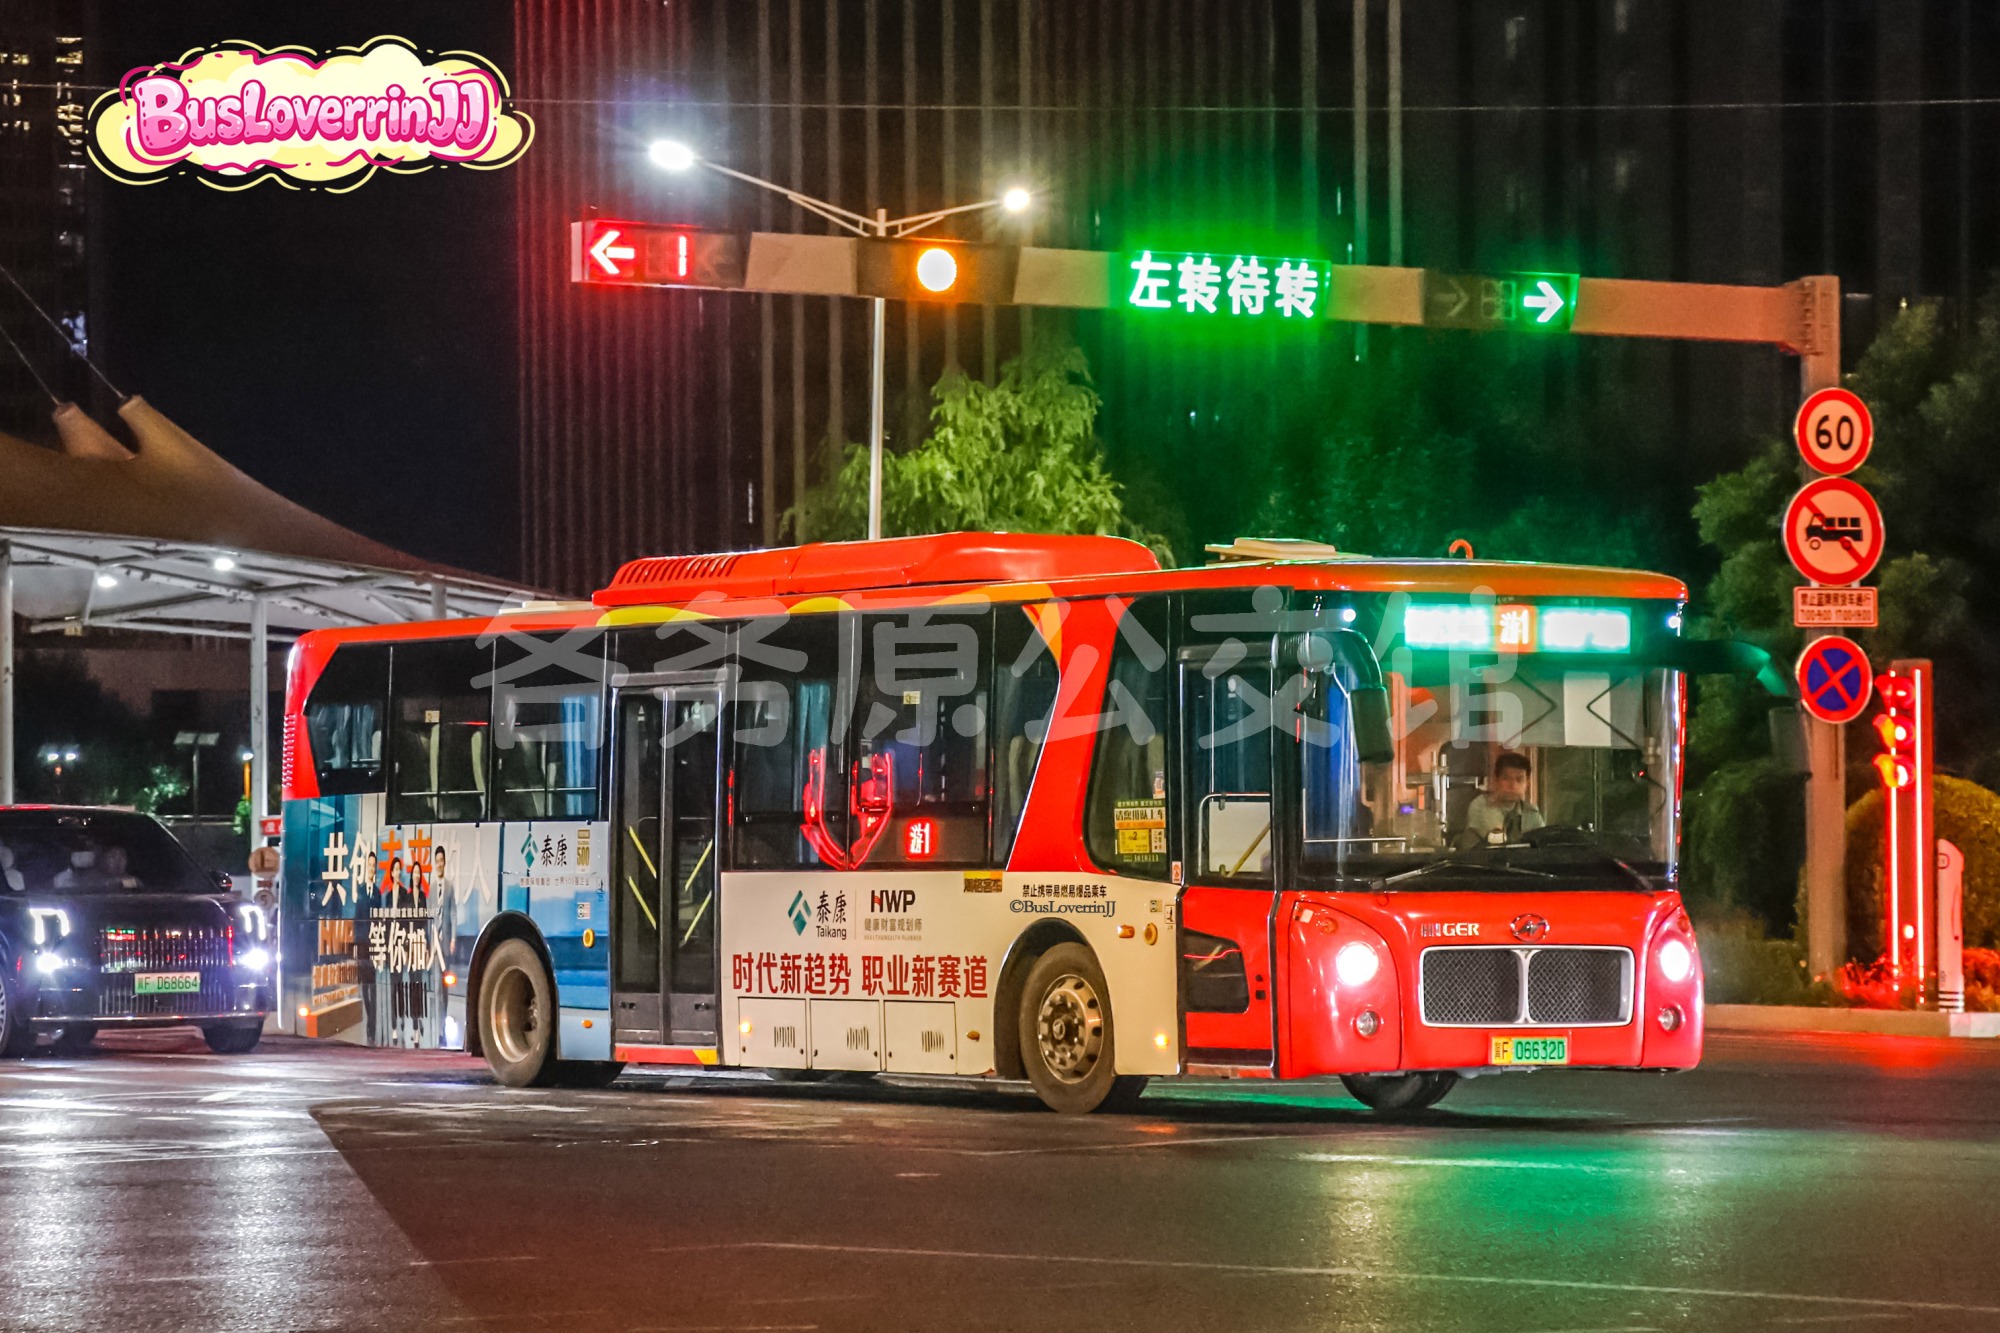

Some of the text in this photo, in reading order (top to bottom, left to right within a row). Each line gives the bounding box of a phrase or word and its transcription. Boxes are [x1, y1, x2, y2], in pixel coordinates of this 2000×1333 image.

[1129, 250, 1319, 319] 左转待转
[1815, 414, 1855, 451] 60
[541, 833, 568, 867] 泰康
[577, 846, 590, 866] 500
[870, 889, 916, 913] HWP
[1022, 884, 1107, 898] 禁止携带易燃易爆品乘车
[815, 890, 847, 924] 泰康
[816, 925, 847, 940] Taikang
[1421, 922, 1480, 937] HIGER
[368, 920, 446, 974] 等你加入
[157, 976, 198, 990] D68664
[732, 951, 988, 999] 时代新趋势 职业新赛道
[1515, 1041, 1565, 1060] 06632D
